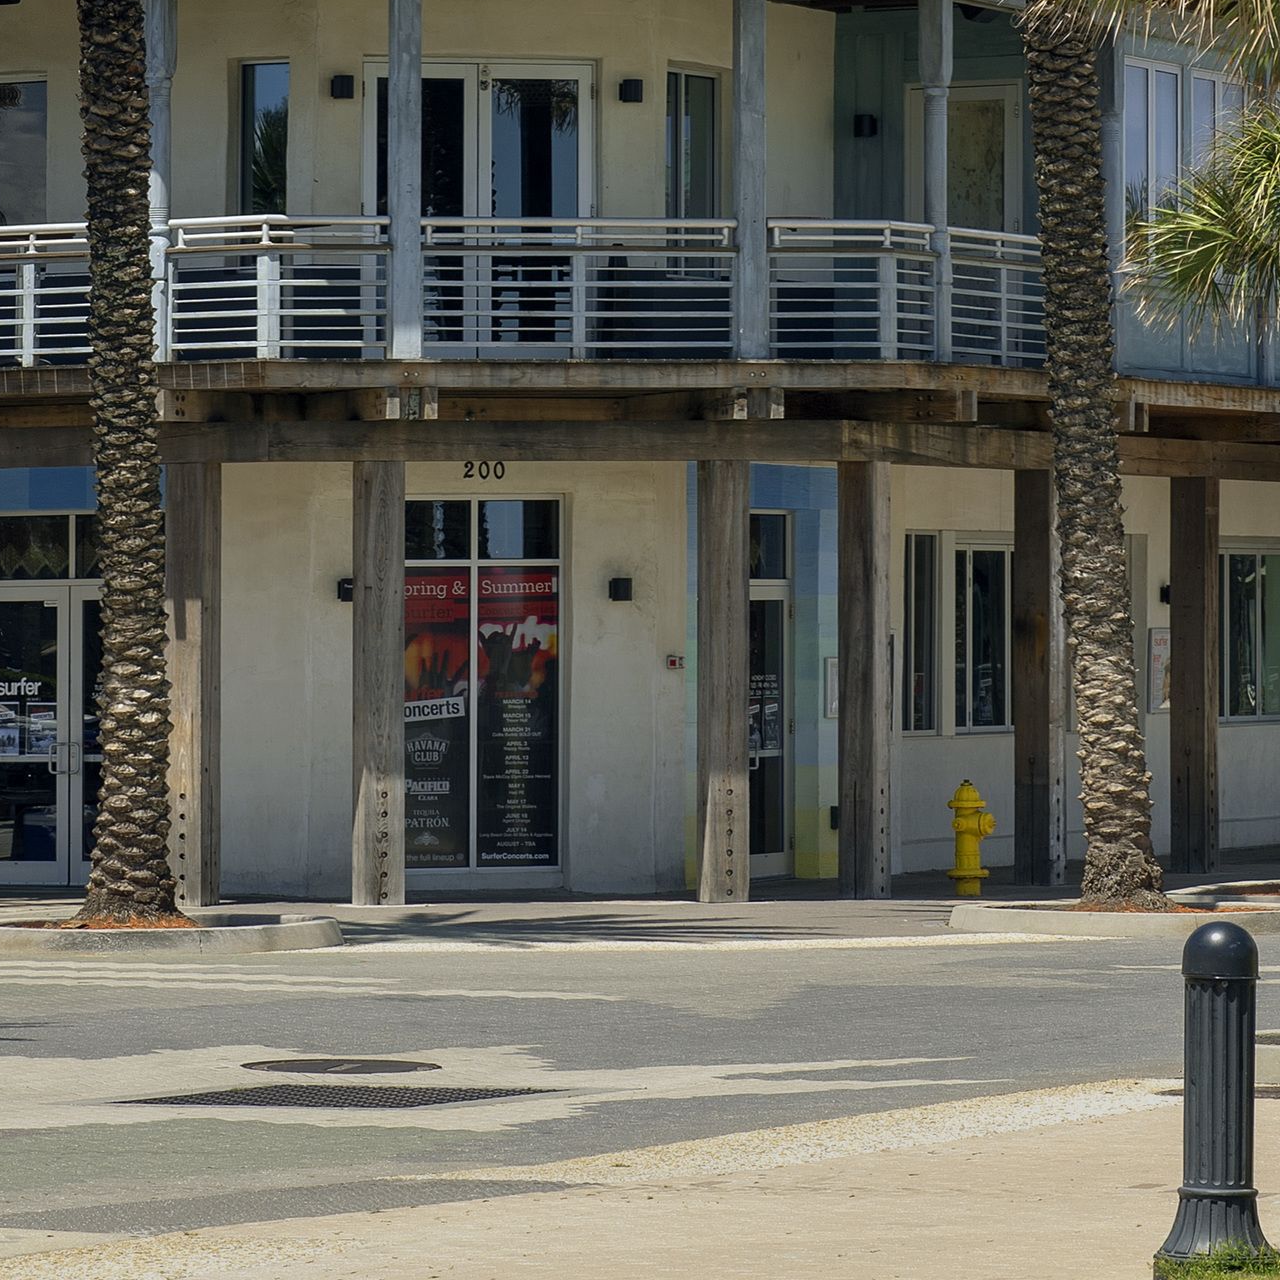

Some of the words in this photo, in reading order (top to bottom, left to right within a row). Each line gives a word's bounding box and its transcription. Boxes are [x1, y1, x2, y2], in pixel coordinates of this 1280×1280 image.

[463, 461, 505, 480] 200
[404, 580, 448, 599] pring
[452, 581, 466, 595] &
[481, 580, 552, 594] Summer
[404, 700, 460, 718] oncerts
[407, 740, 448, 753] HAVANA
[414, 751, 439, 762] CLUB
[481, 852, 550, 860] SurferConcerts.com
